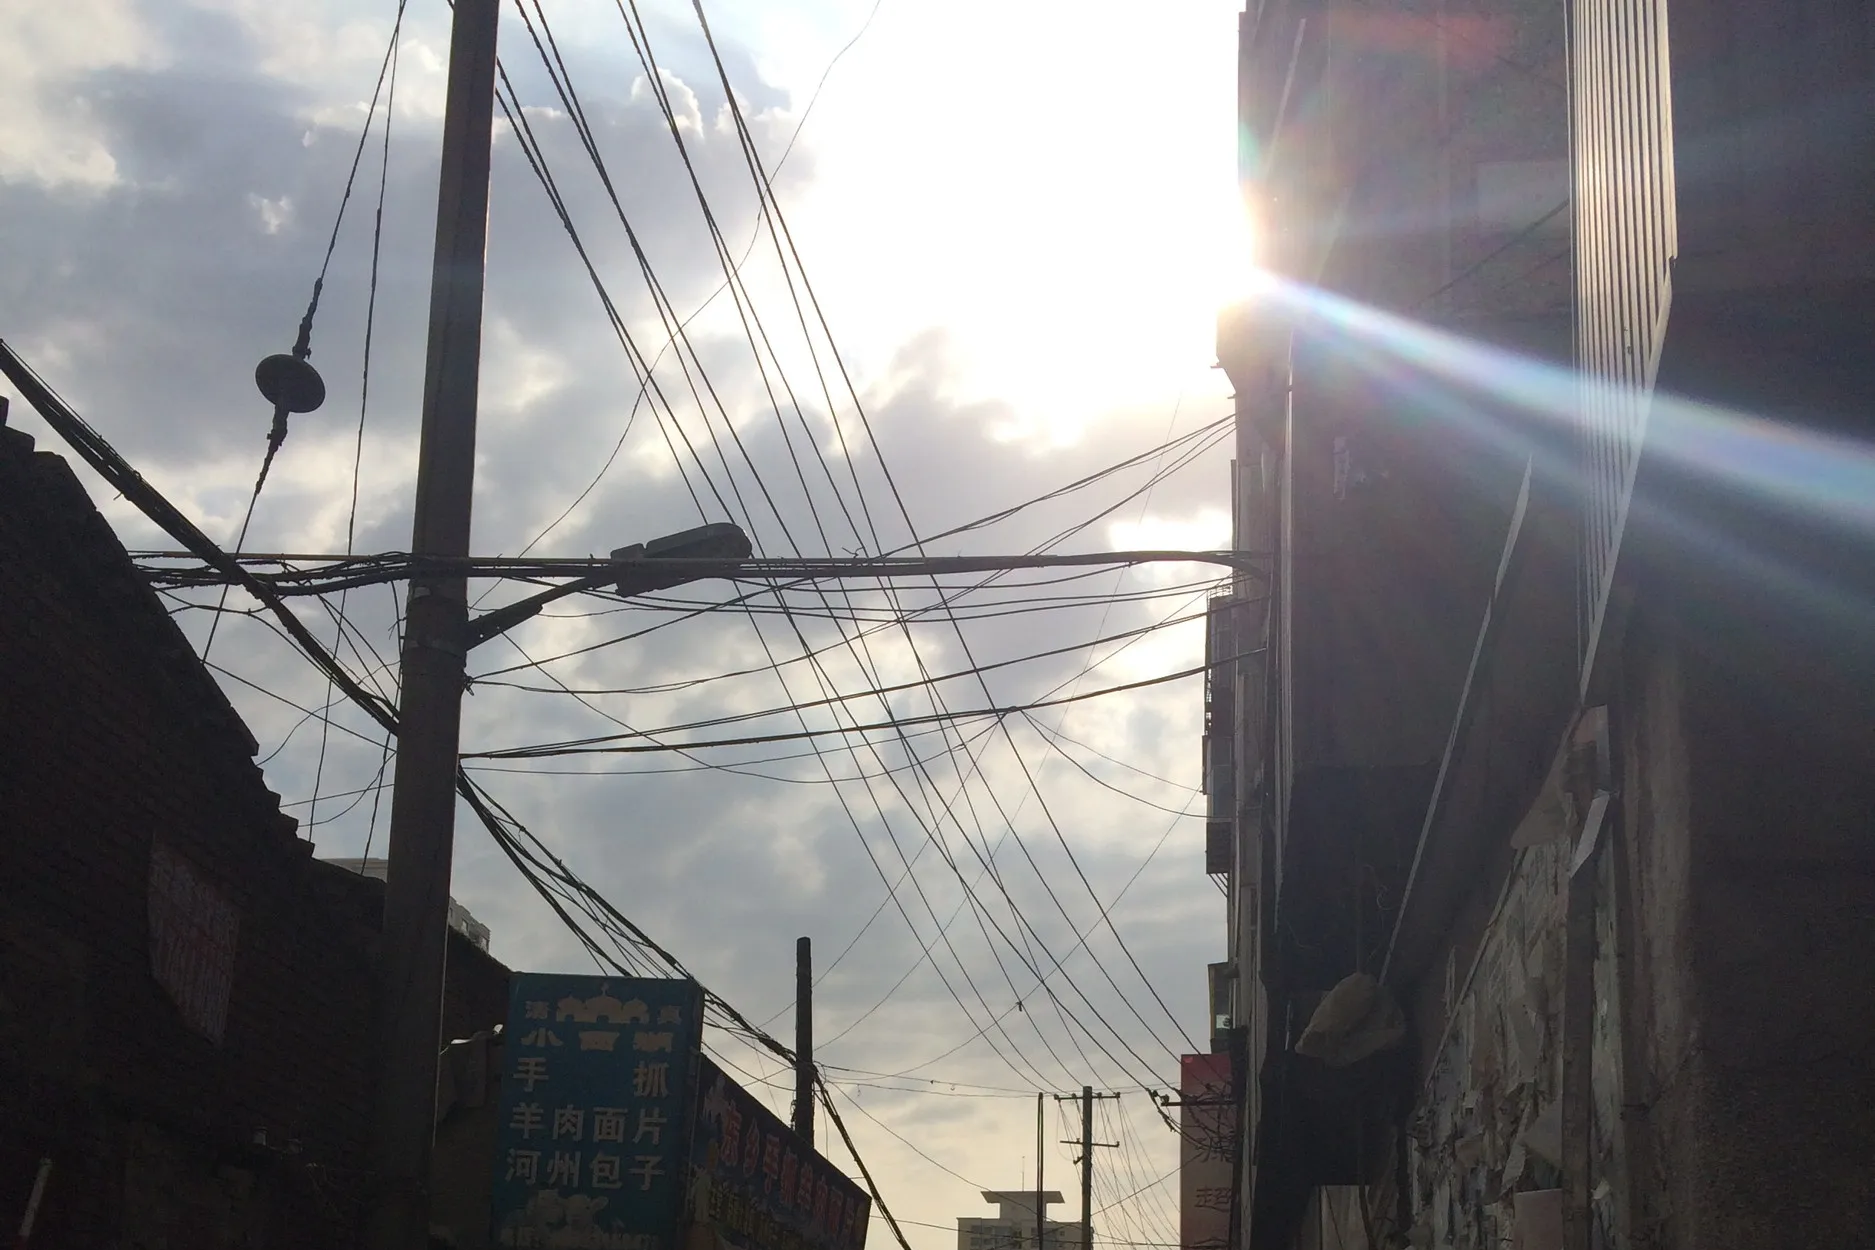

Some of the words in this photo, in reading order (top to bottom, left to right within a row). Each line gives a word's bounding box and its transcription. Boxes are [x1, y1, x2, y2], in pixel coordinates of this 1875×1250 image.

[509, 1102, 667, 1146] 羊肉面片
[505, 1147, 665, 1191] 河州包子
